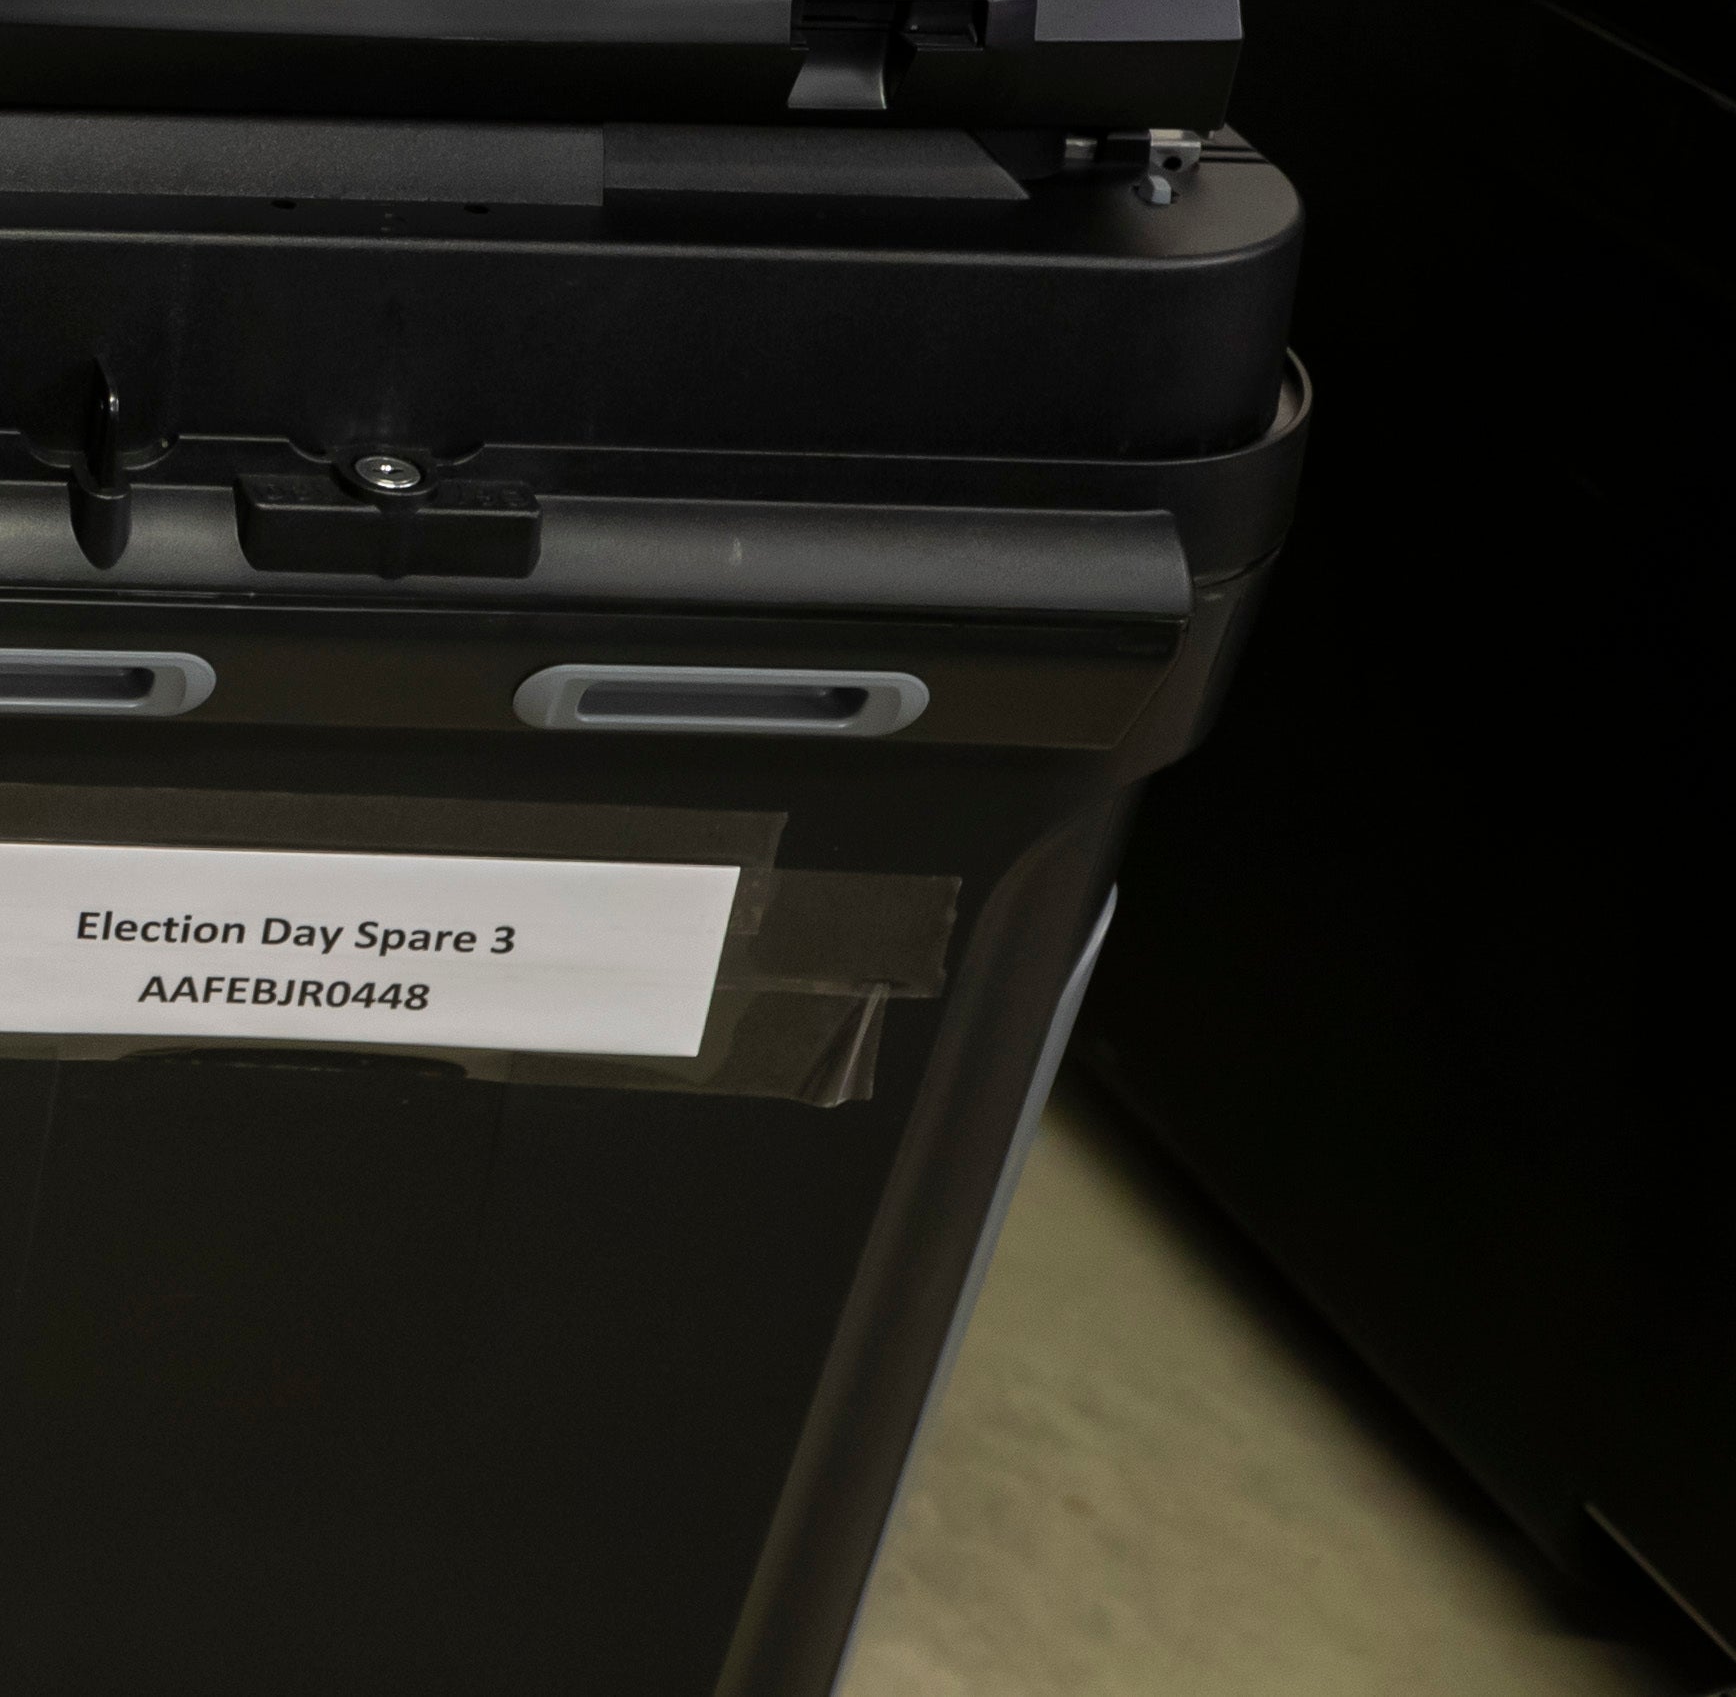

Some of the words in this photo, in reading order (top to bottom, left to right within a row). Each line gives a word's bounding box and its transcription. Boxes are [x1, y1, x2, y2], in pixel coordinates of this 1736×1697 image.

[77, 911, 246, 944] Election
[261, 917, 344, 955] Day
[354, 921, 477, 956] Spare
[490, 925, 516, 954] 3
[137, 976, 430, 1011] AAFEBJR0448
